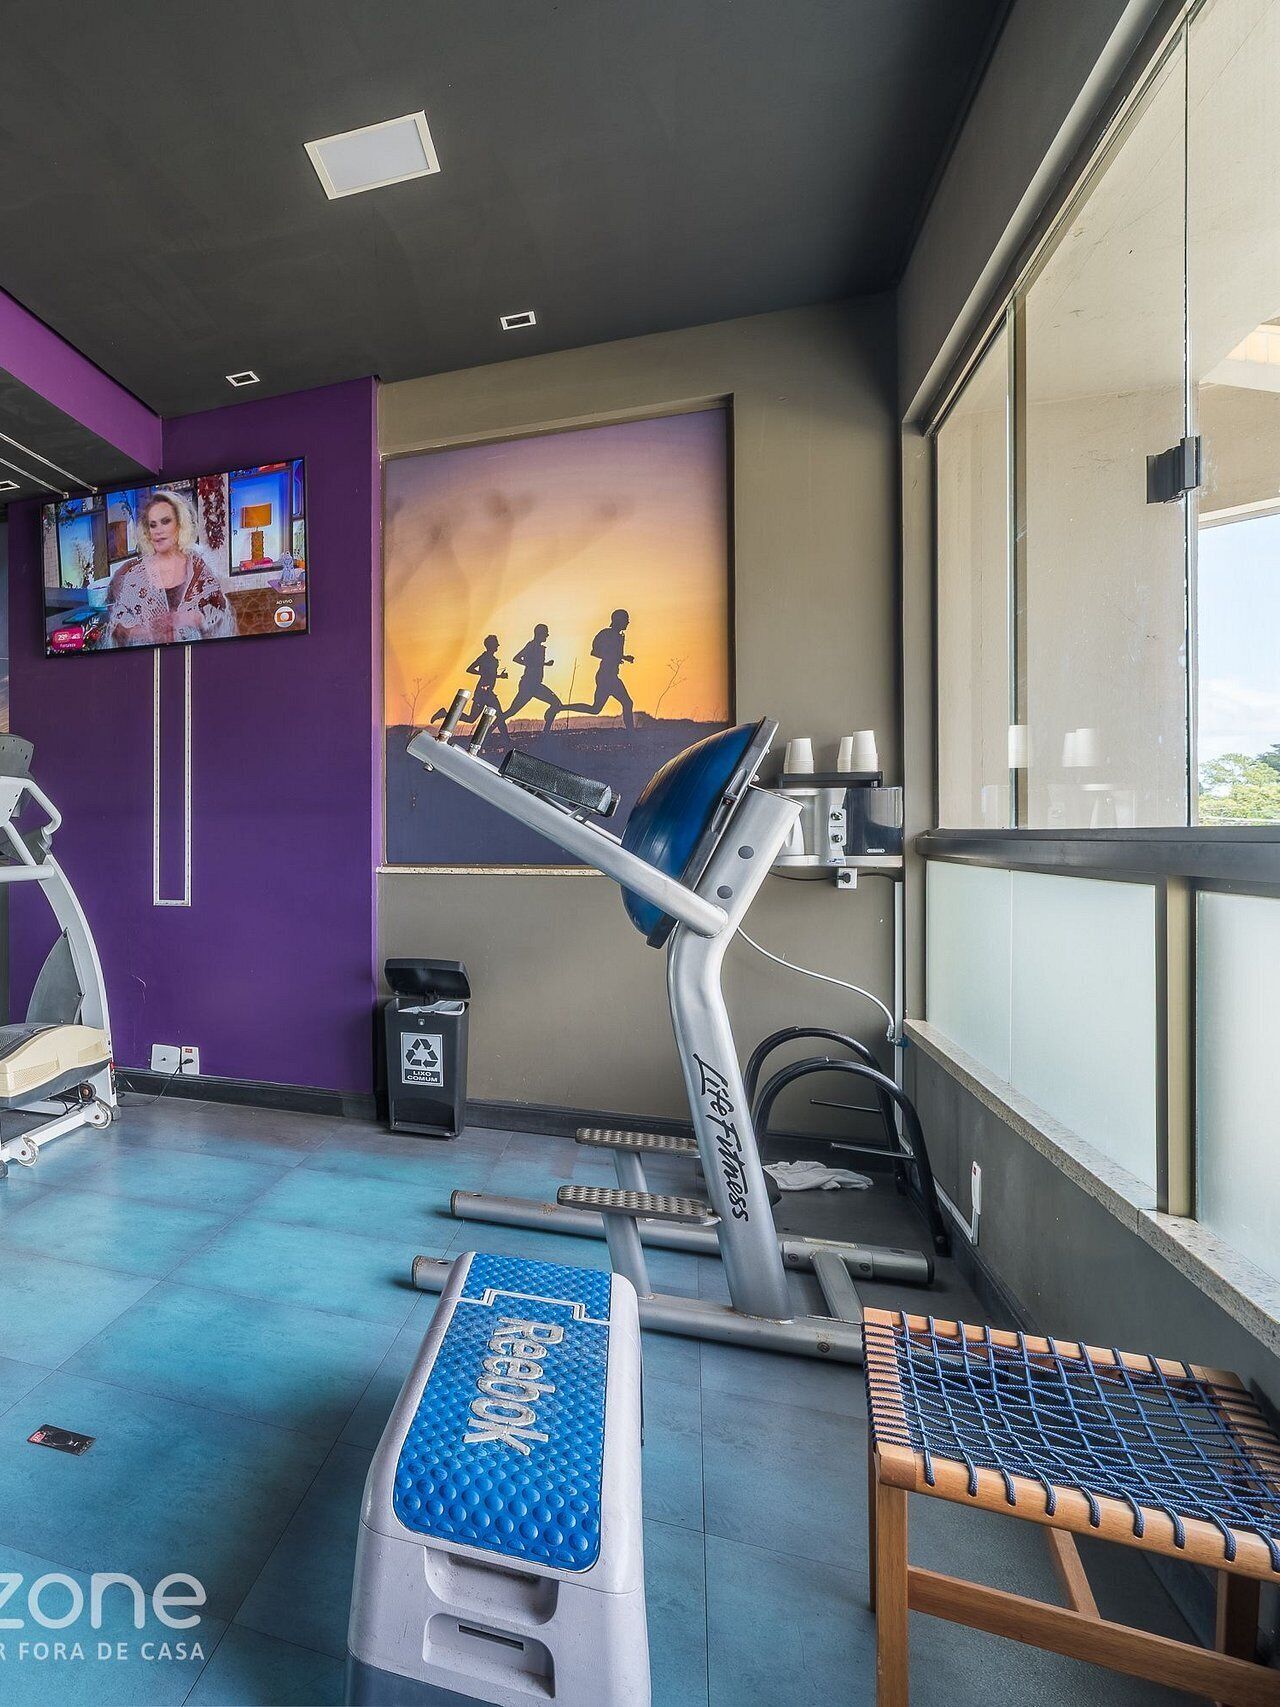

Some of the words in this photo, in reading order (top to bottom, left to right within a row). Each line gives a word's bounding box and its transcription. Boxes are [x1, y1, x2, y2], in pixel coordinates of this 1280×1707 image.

[407, 1075, 438, 1083] COMUM
[693, 1053, 734, 1117] Life
[706, 1113, 750, 1222] Fitness
[463, 1316, 564, 1456] Reebok
